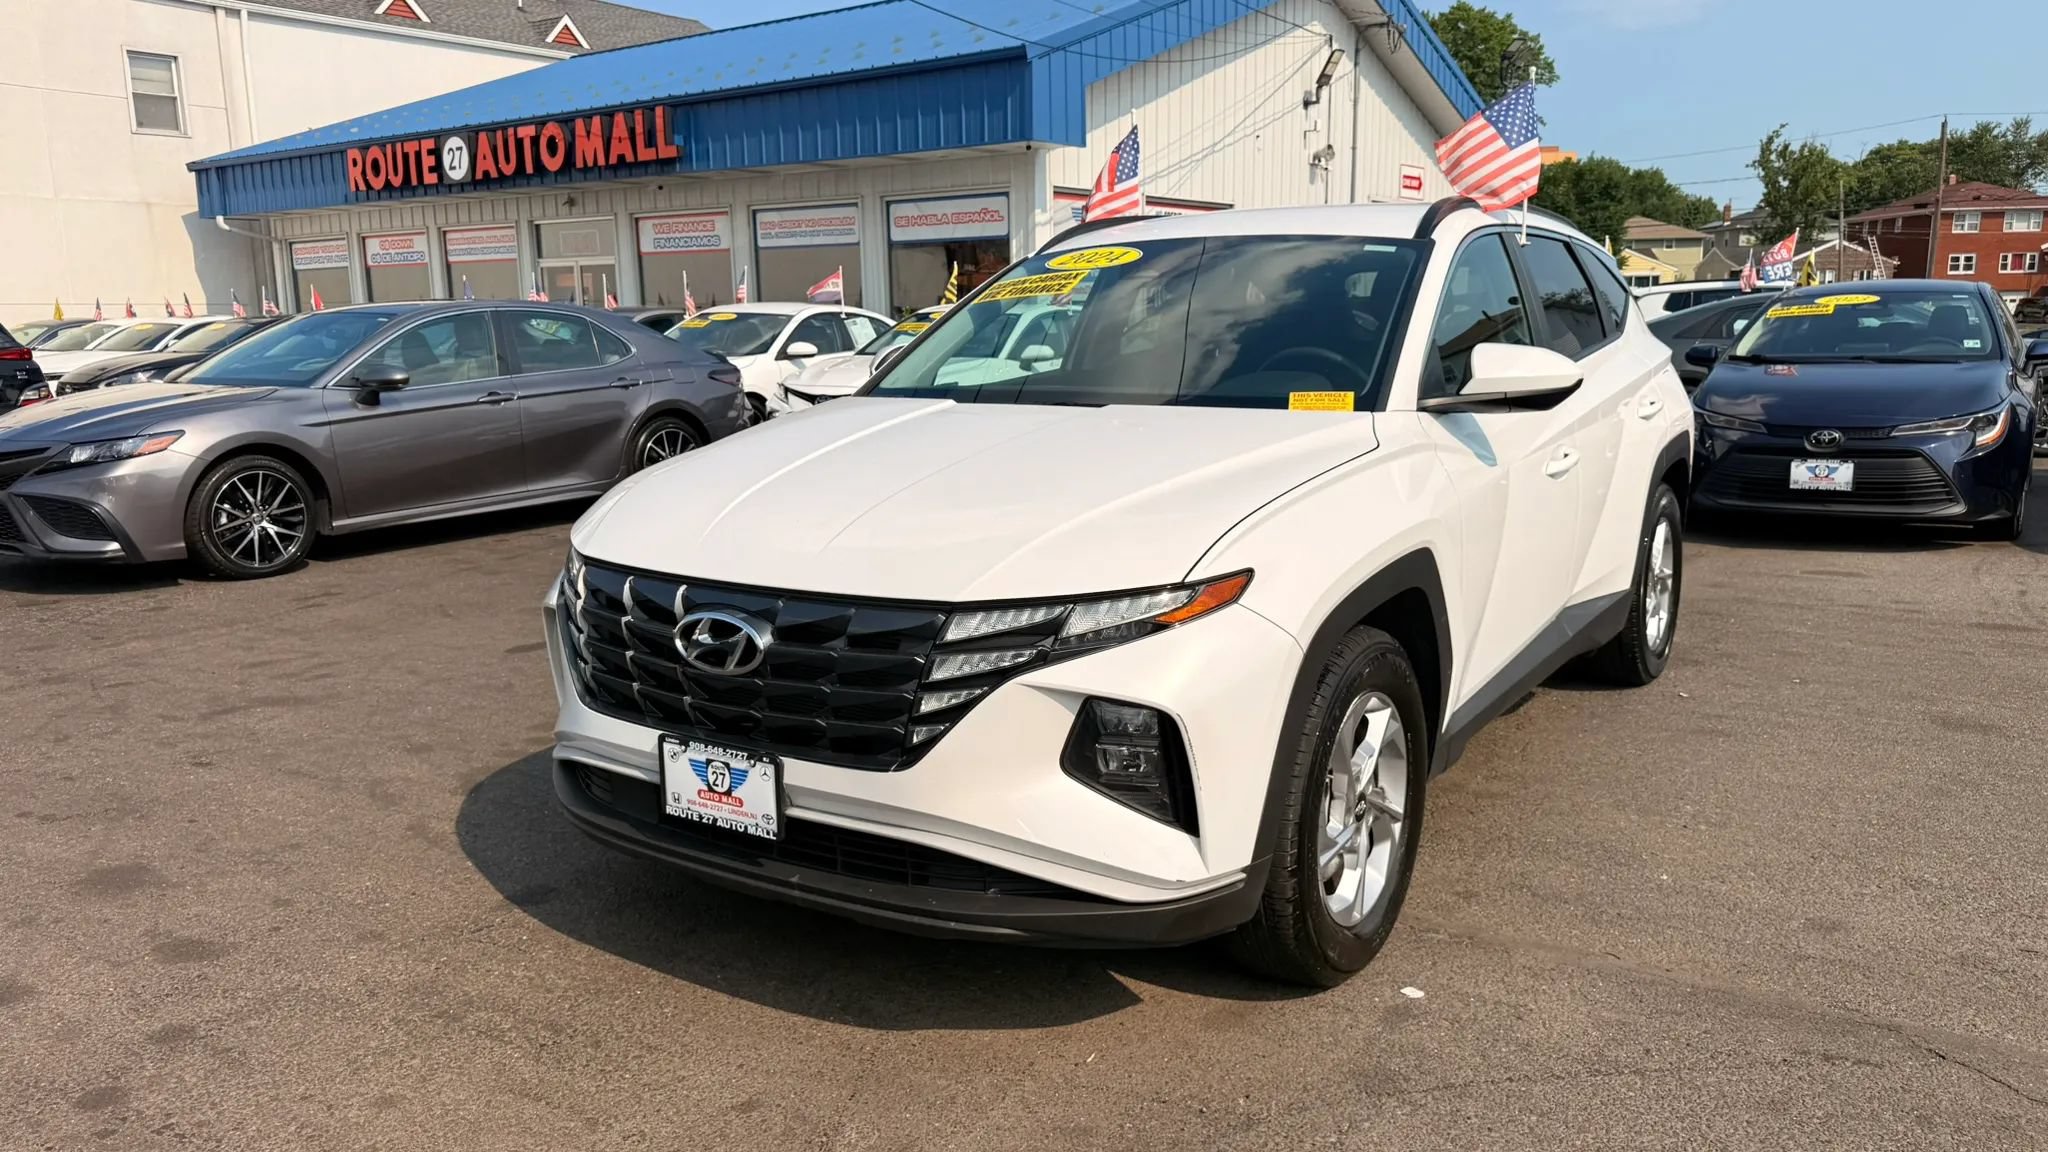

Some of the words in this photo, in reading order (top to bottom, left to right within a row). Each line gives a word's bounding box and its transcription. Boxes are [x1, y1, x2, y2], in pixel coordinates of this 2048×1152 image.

[346, 138, 439, 192] ROUTE
[447, 145, 463, 172] 27
[475, 121, 566, 180] AUTO
[575, 105, 678, 169] MALL
[760, 221, 776, 230] BAD
[778, 219, 804, 229] CREDIT
[805, 218, 817, 228] NO
[818, 216, 856, 227] PROBLEM
[895, 216, 909, 228] SE
[911, 213, 950, 226] HABLA
[952, 208, 1004, 224] ESPAÑOL
[652, 223, 670, 234] WE
[670, 220, 716, 234] FINANCE
[391, 238, 415, 250] DOWN
[653, 235, 721, 249] FINANCIAMOS
[383, 252, 393, 263] DE
[1060, 251, 1129, 266] 2024
[1030, 271, 1084, 284] CARFAX
[1001, 282, 1074, 298] FINANCE
[689, 741, 748, 760] 908-648-2727
[711, 770, 727, 789] 27
[700, 791, 720, 802] AUTO
[721, 796, 742, 807] MALL
[666, 805, 700, 821] ROUTE
[701, 813, 715, 825] 27
[716, 817, 745, 832] AUTO
[747, 825, 777, 840] MALL
